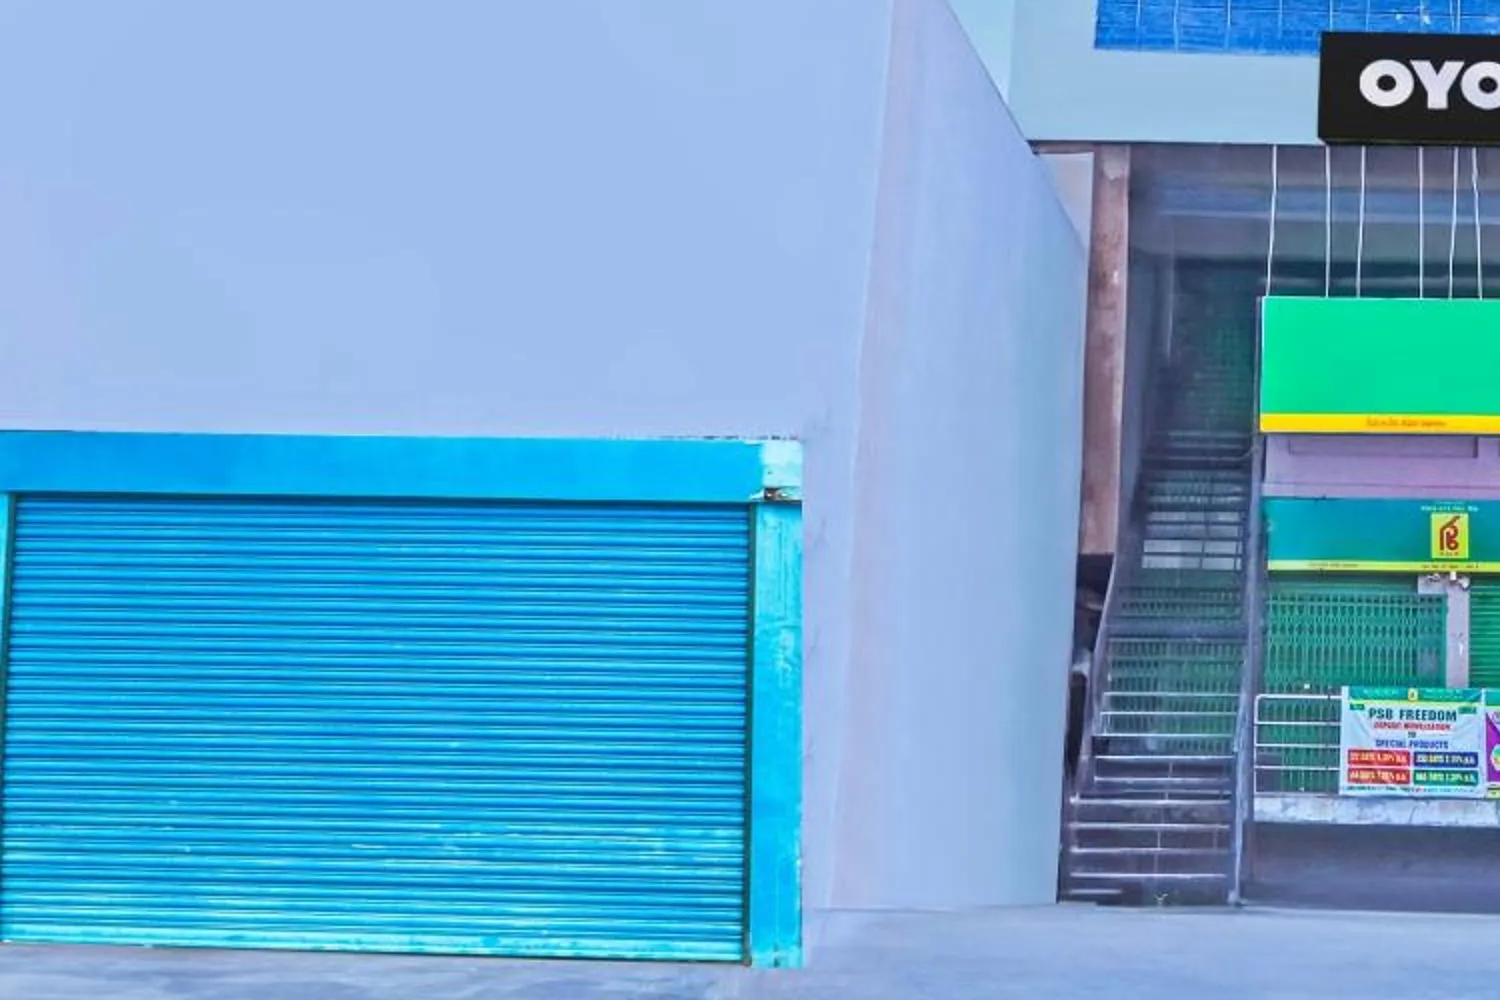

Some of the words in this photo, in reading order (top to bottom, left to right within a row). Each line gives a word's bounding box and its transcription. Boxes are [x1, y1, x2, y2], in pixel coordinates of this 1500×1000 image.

[1368, 707, 1394, 720] PSB
[1399, 708, 1457, 722] FREEDOM
[1409, 739, 1450, 750] PRODUCTS
